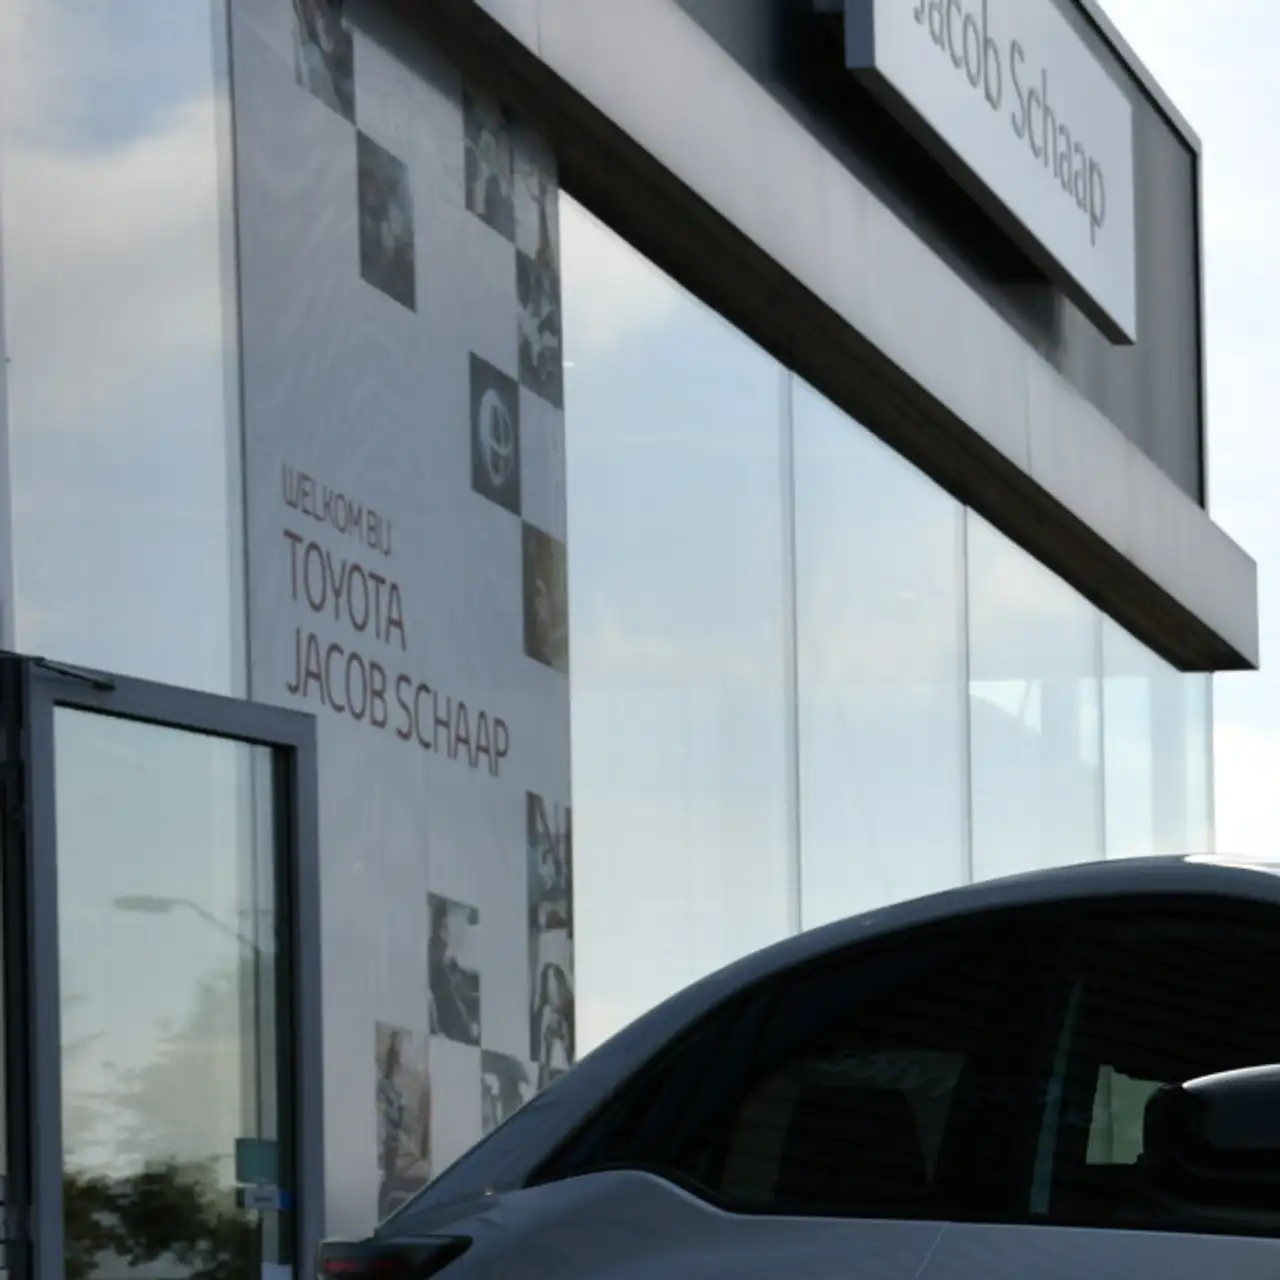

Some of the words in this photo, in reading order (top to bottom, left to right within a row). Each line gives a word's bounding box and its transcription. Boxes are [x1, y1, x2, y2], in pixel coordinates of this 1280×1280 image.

[912, 0, 1002, 111] acob
[1009, 39, 1106, 247] Schaap
[281, 462, 363, 543] WELKOM
[366, 507, 393, 557] BIJ
[282, 527, 407, 652] TOYOTA
[285, 626, 389, 729] JACOB
[395, 672, 510, 777] SCHAAP
